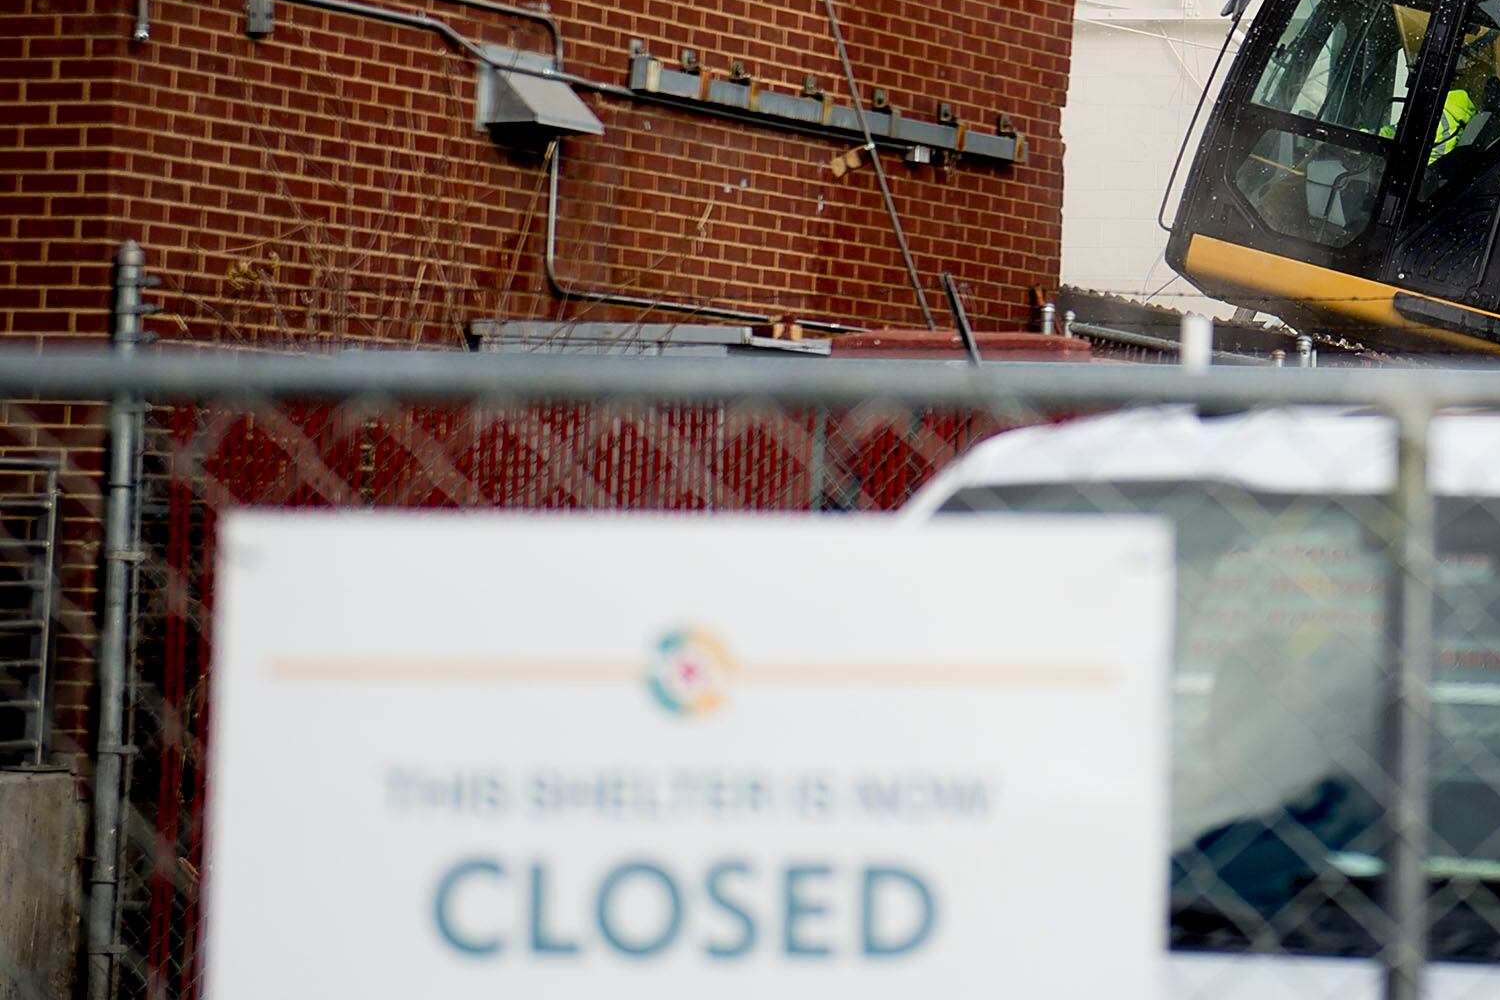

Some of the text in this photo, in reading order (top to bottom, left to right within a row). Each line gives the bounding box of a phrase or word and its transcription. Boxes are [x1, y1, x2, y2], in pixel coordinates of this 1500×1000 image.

[384, 766, 992, 820] THIS SHELTER IS NOW
[430, 856, 940, 962] CLOSED
